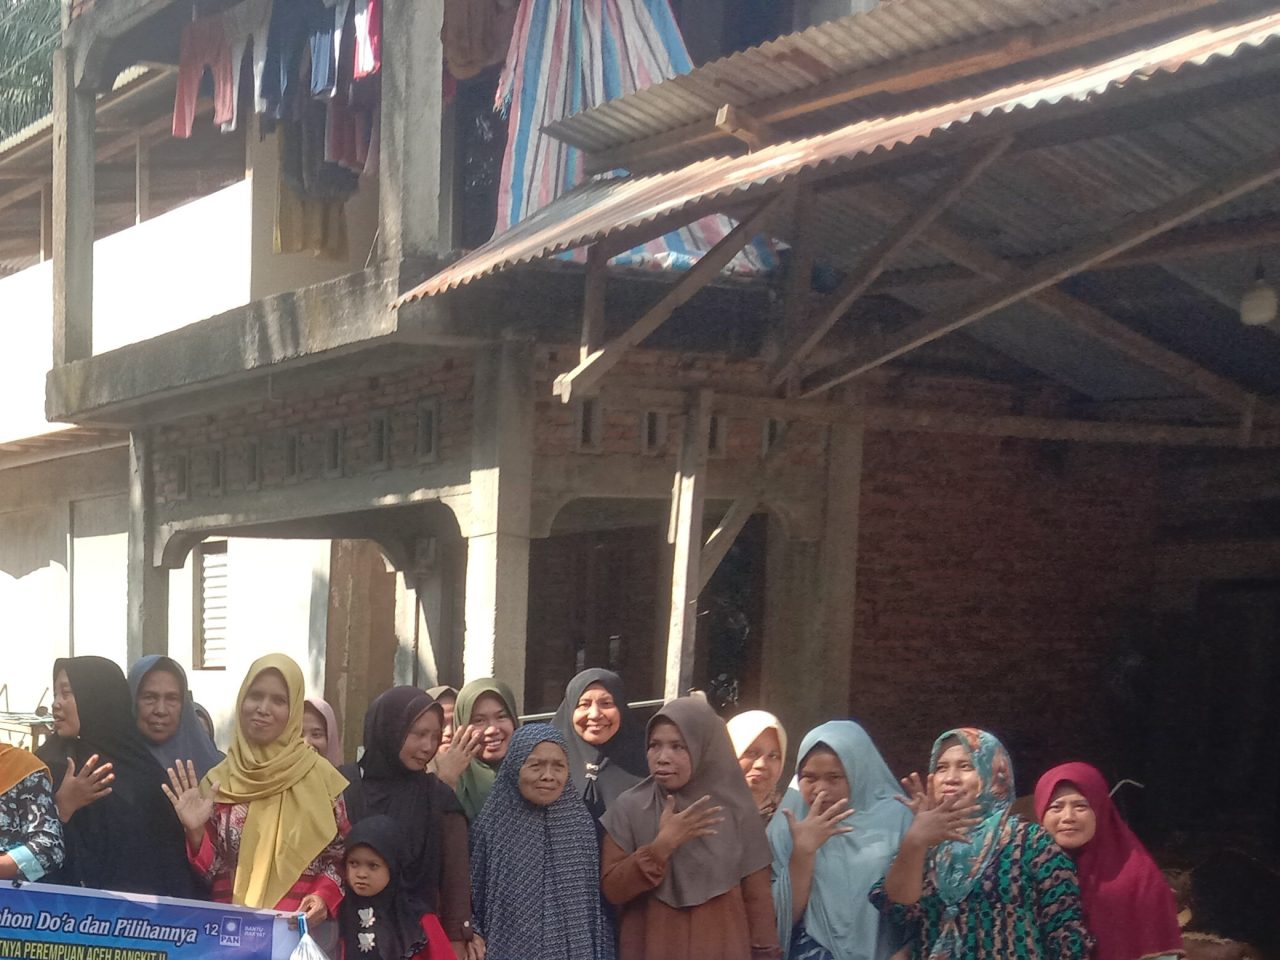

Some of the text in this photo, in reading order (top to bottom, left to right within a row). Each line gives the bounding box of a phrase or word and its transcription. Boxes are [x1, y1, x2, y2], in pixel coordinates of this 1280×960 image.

[37, 912, 75, 932] Do'a
[79, 917, 110, 935] dan
[114, 919, 197, 945] Pilihannya
[204, 923, 240, 944] 12 PAN
